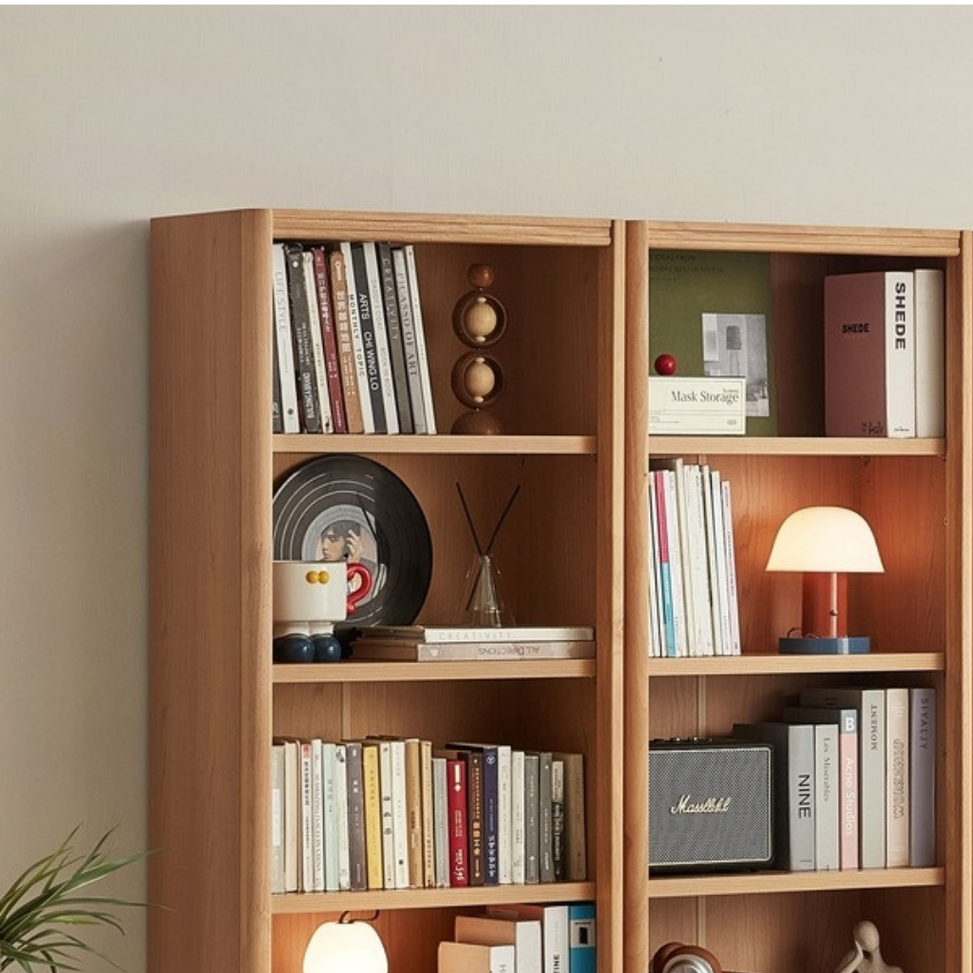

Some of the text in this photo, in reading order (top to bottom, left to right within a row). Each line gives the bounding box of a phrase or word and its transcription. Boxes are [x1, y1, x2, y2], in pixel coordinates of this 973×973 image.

[350, 294, 366, 378] MONTHLY TOPIC
[398, 272, 418, 377] PICASSO OF ART
[842, 323, 870, 335] SHEDE
[895, 281, 906, 350] SHEDE
[358, 293, 379, 391] ARTS CHI WING LO
[670, 390, 740, 405] Mask Storage
[438, 631, 512, 641] CREATIVITY
[524, 647, 539, 655] ALL
[823, 736, 831, 752] Les
[870, 705, 878, 751] MOMENT
[798, 774, 812, 819] NINE
[845, 791, 854, 836] Studios
